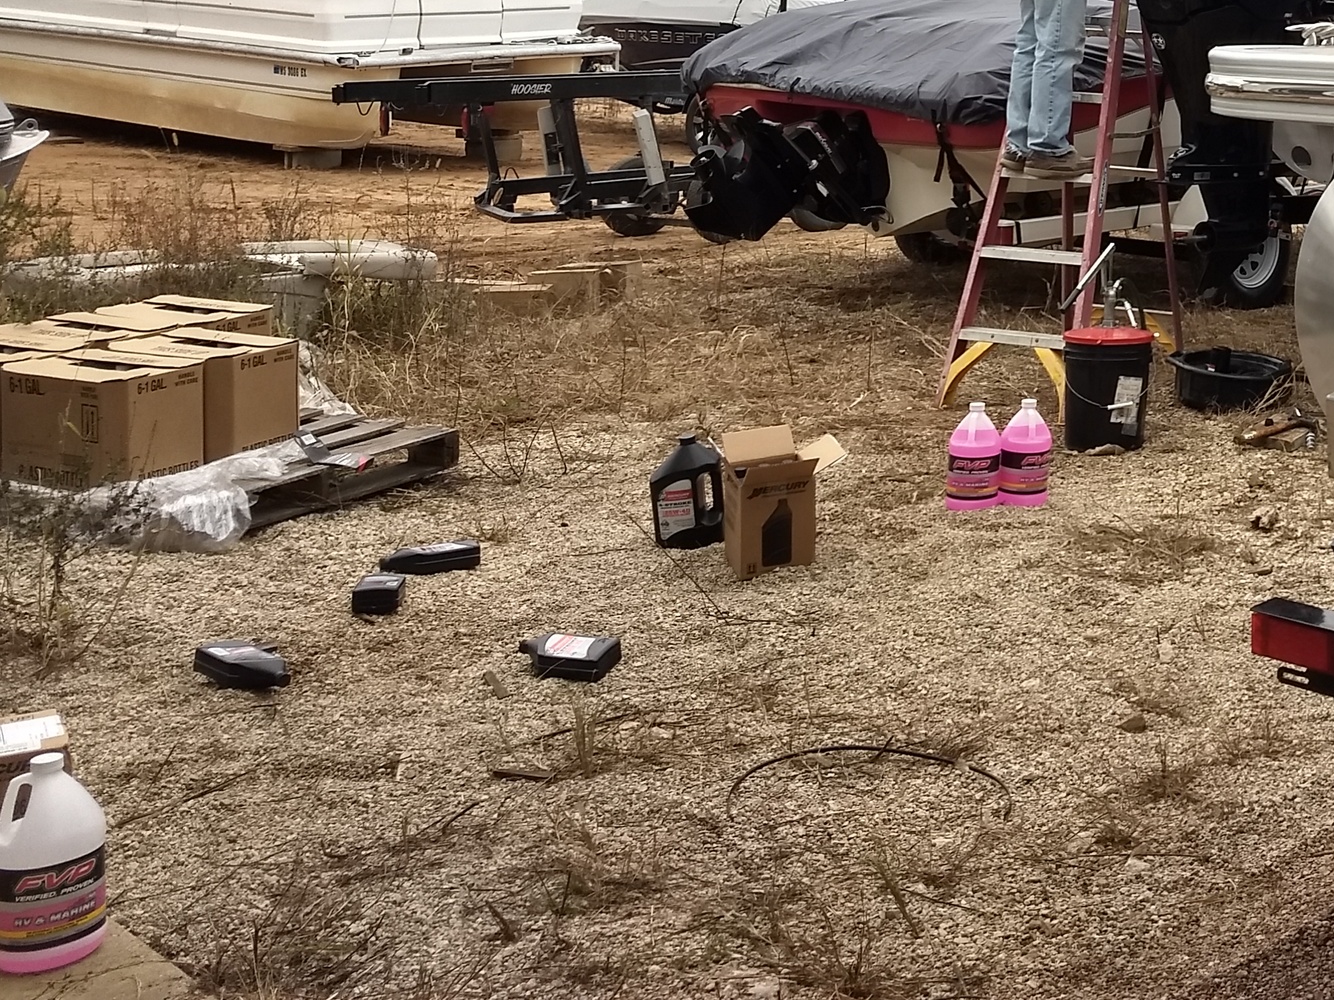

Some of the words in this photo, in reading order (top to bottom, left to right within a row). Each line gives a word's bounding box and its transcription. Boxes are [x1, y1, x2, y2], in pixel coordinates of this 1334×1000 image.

[511, 84, 552, 96] HOOSIER
[240, 358, 252, 371] 6-1
[9, 376, 24, 394] 6-1
[136, 381, 150, 395] 6-1
[953, 460, 991, 471] FVP
[747, 480, 810, 500] MERCURY
[14, 857, 97, 894] FVP
[35, 915, 45, 926] &
[49, 900, 97, 923] MARINE
